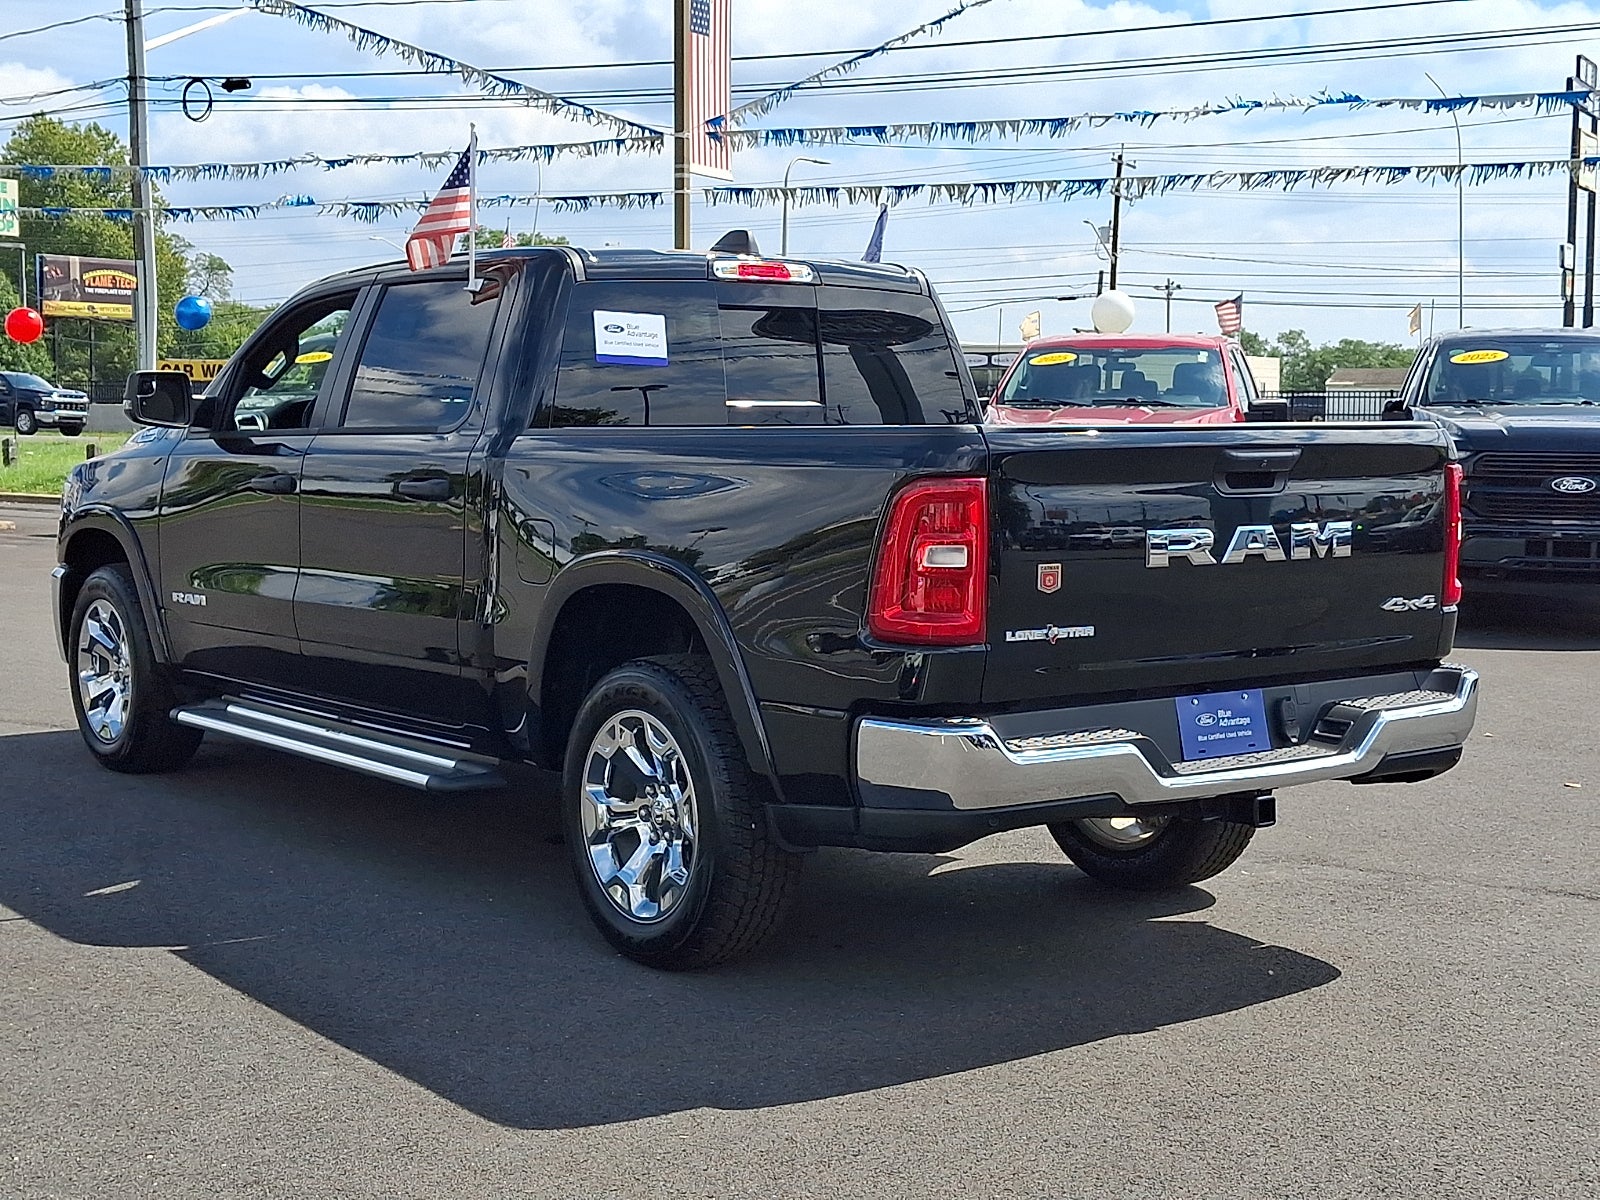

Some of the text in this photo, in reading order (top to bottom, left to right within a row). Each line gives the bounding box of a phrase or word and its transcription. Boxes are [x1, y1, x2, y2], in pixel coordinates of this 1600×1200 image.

[85, 274, 138, 289] FLAME-TECH
[627, 331, 658, 339] Advantage
[1460, 352, 1499, 362] 2025
[1145, 520, 1354, 569] RAM
[171, 591, 207, 607] RAM
[1005, 625, 1096, 642] LONE STAR
[1217, 709, 1232, 718] Blue
[1219, 717, 1251, 727] Advantage
